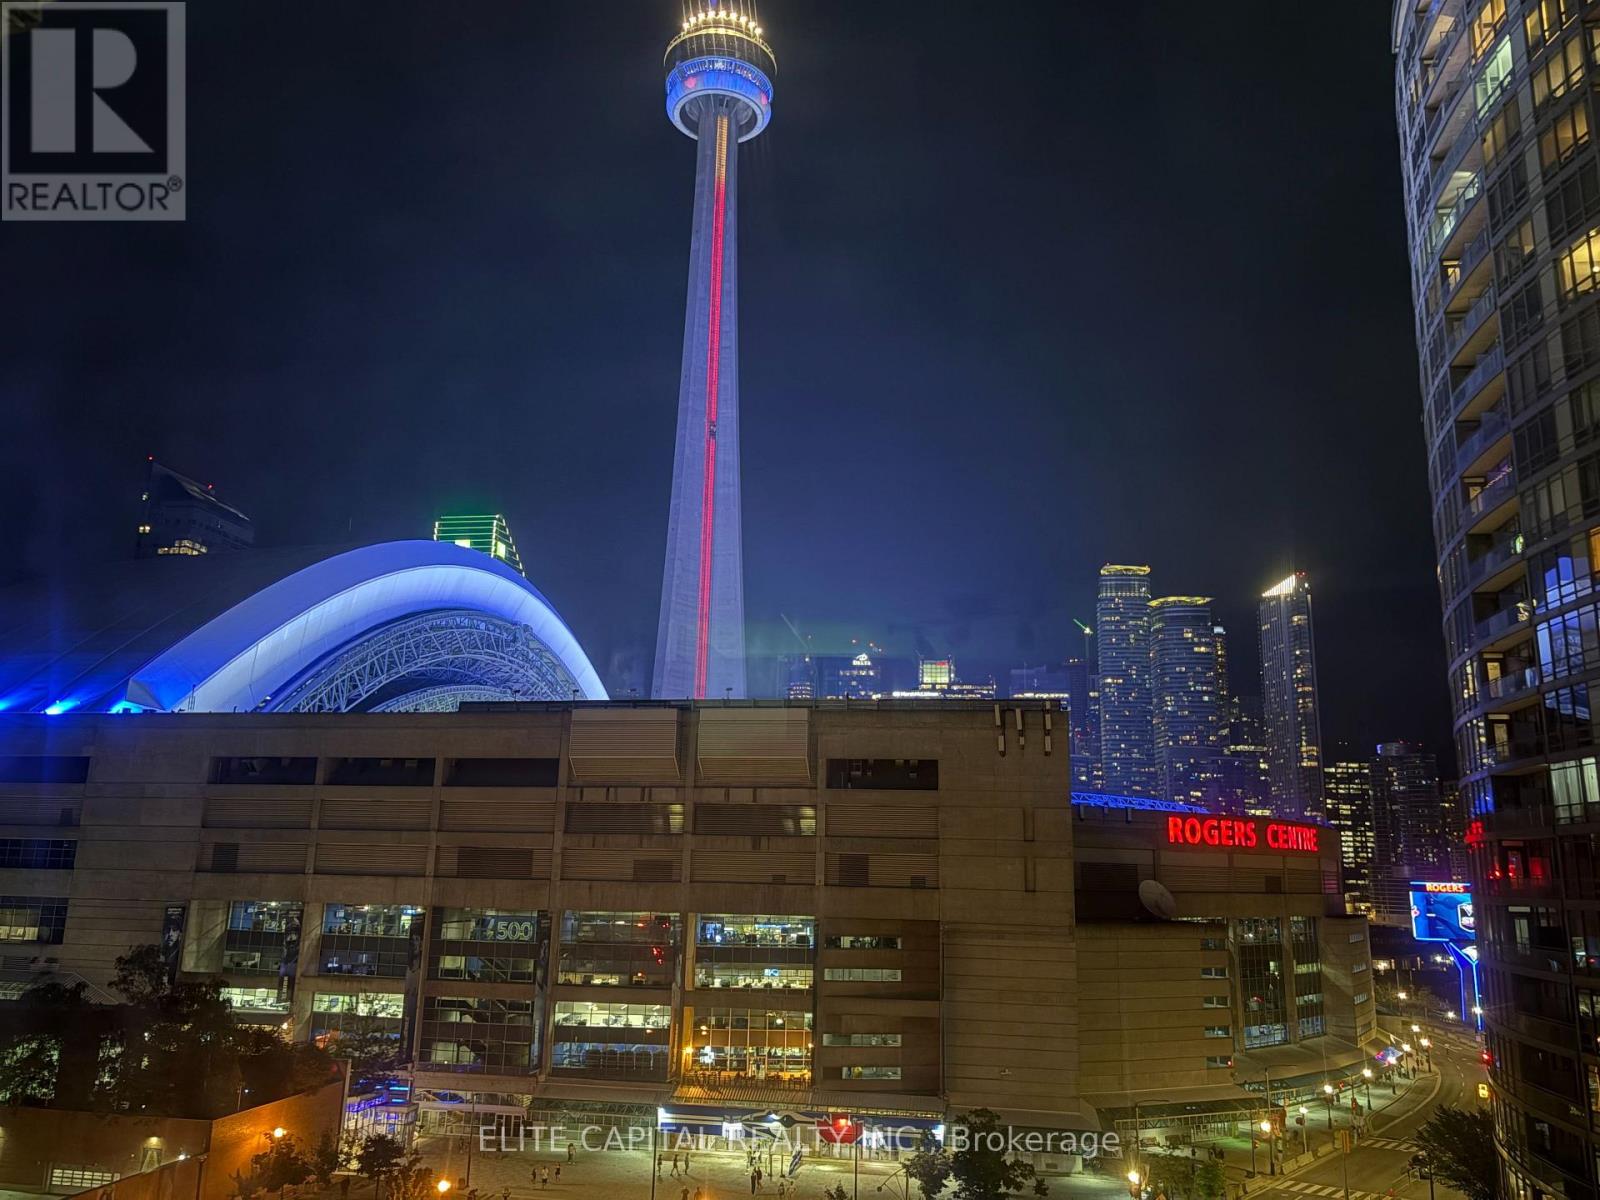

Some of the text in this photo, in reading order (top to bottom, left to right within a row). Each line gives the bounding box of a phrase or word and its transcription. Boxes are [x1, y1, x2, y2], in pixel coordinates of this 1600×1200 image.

[1168, 816, 1319, 853] ROGERS CENTRE
[1426, 882, 1464, 892] ROGERS
[497, 921, 533, 940] 500
